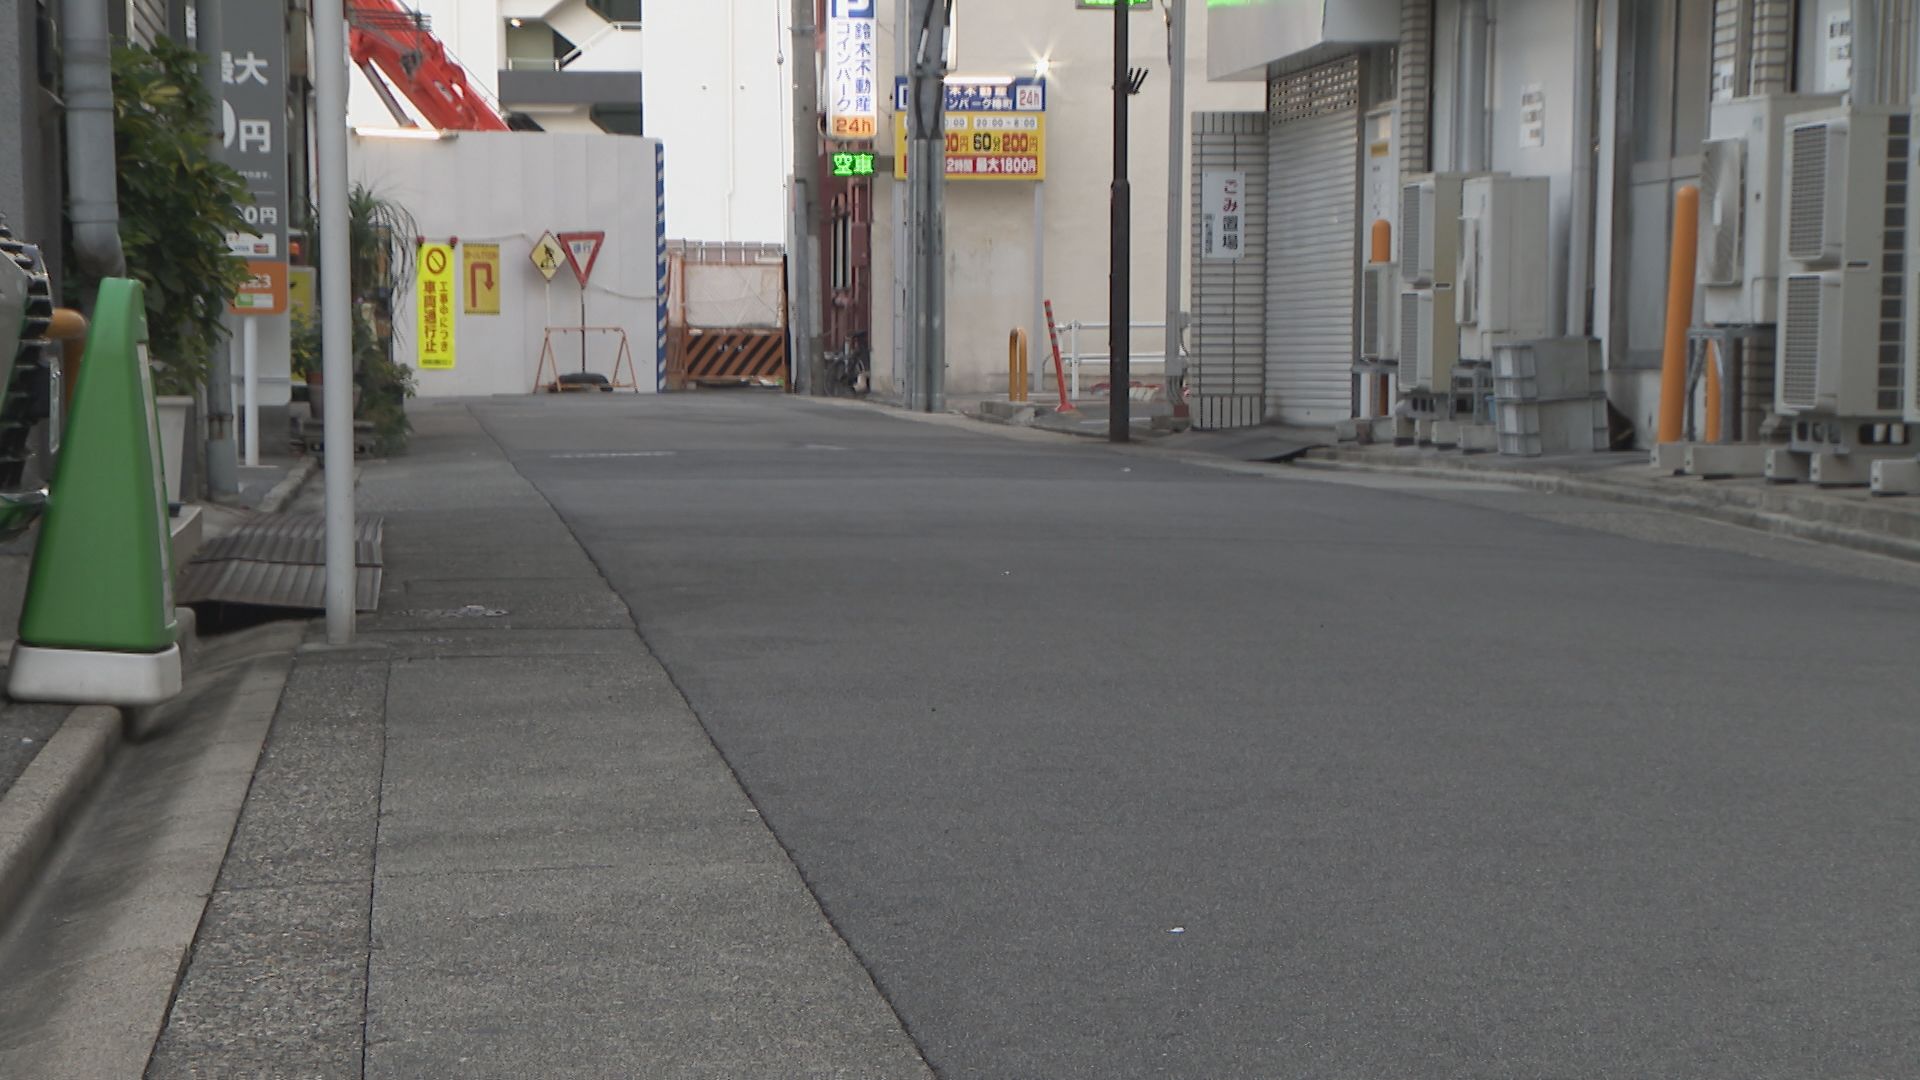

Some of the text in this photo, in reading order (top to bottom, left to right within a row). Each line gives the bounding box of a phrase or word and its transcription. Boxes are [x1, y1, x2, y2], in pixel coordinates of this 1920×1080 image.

[836, 22, 852, 112] コインパーク
[855, 22, 871, 112] 鈴木不動産
[1019, 91, 1040, 106] 24h
[836, 119, 871, 133] 24h
[833, 153, 874, 175] 空車
[424, 280, 437, 353] 車両通行止
